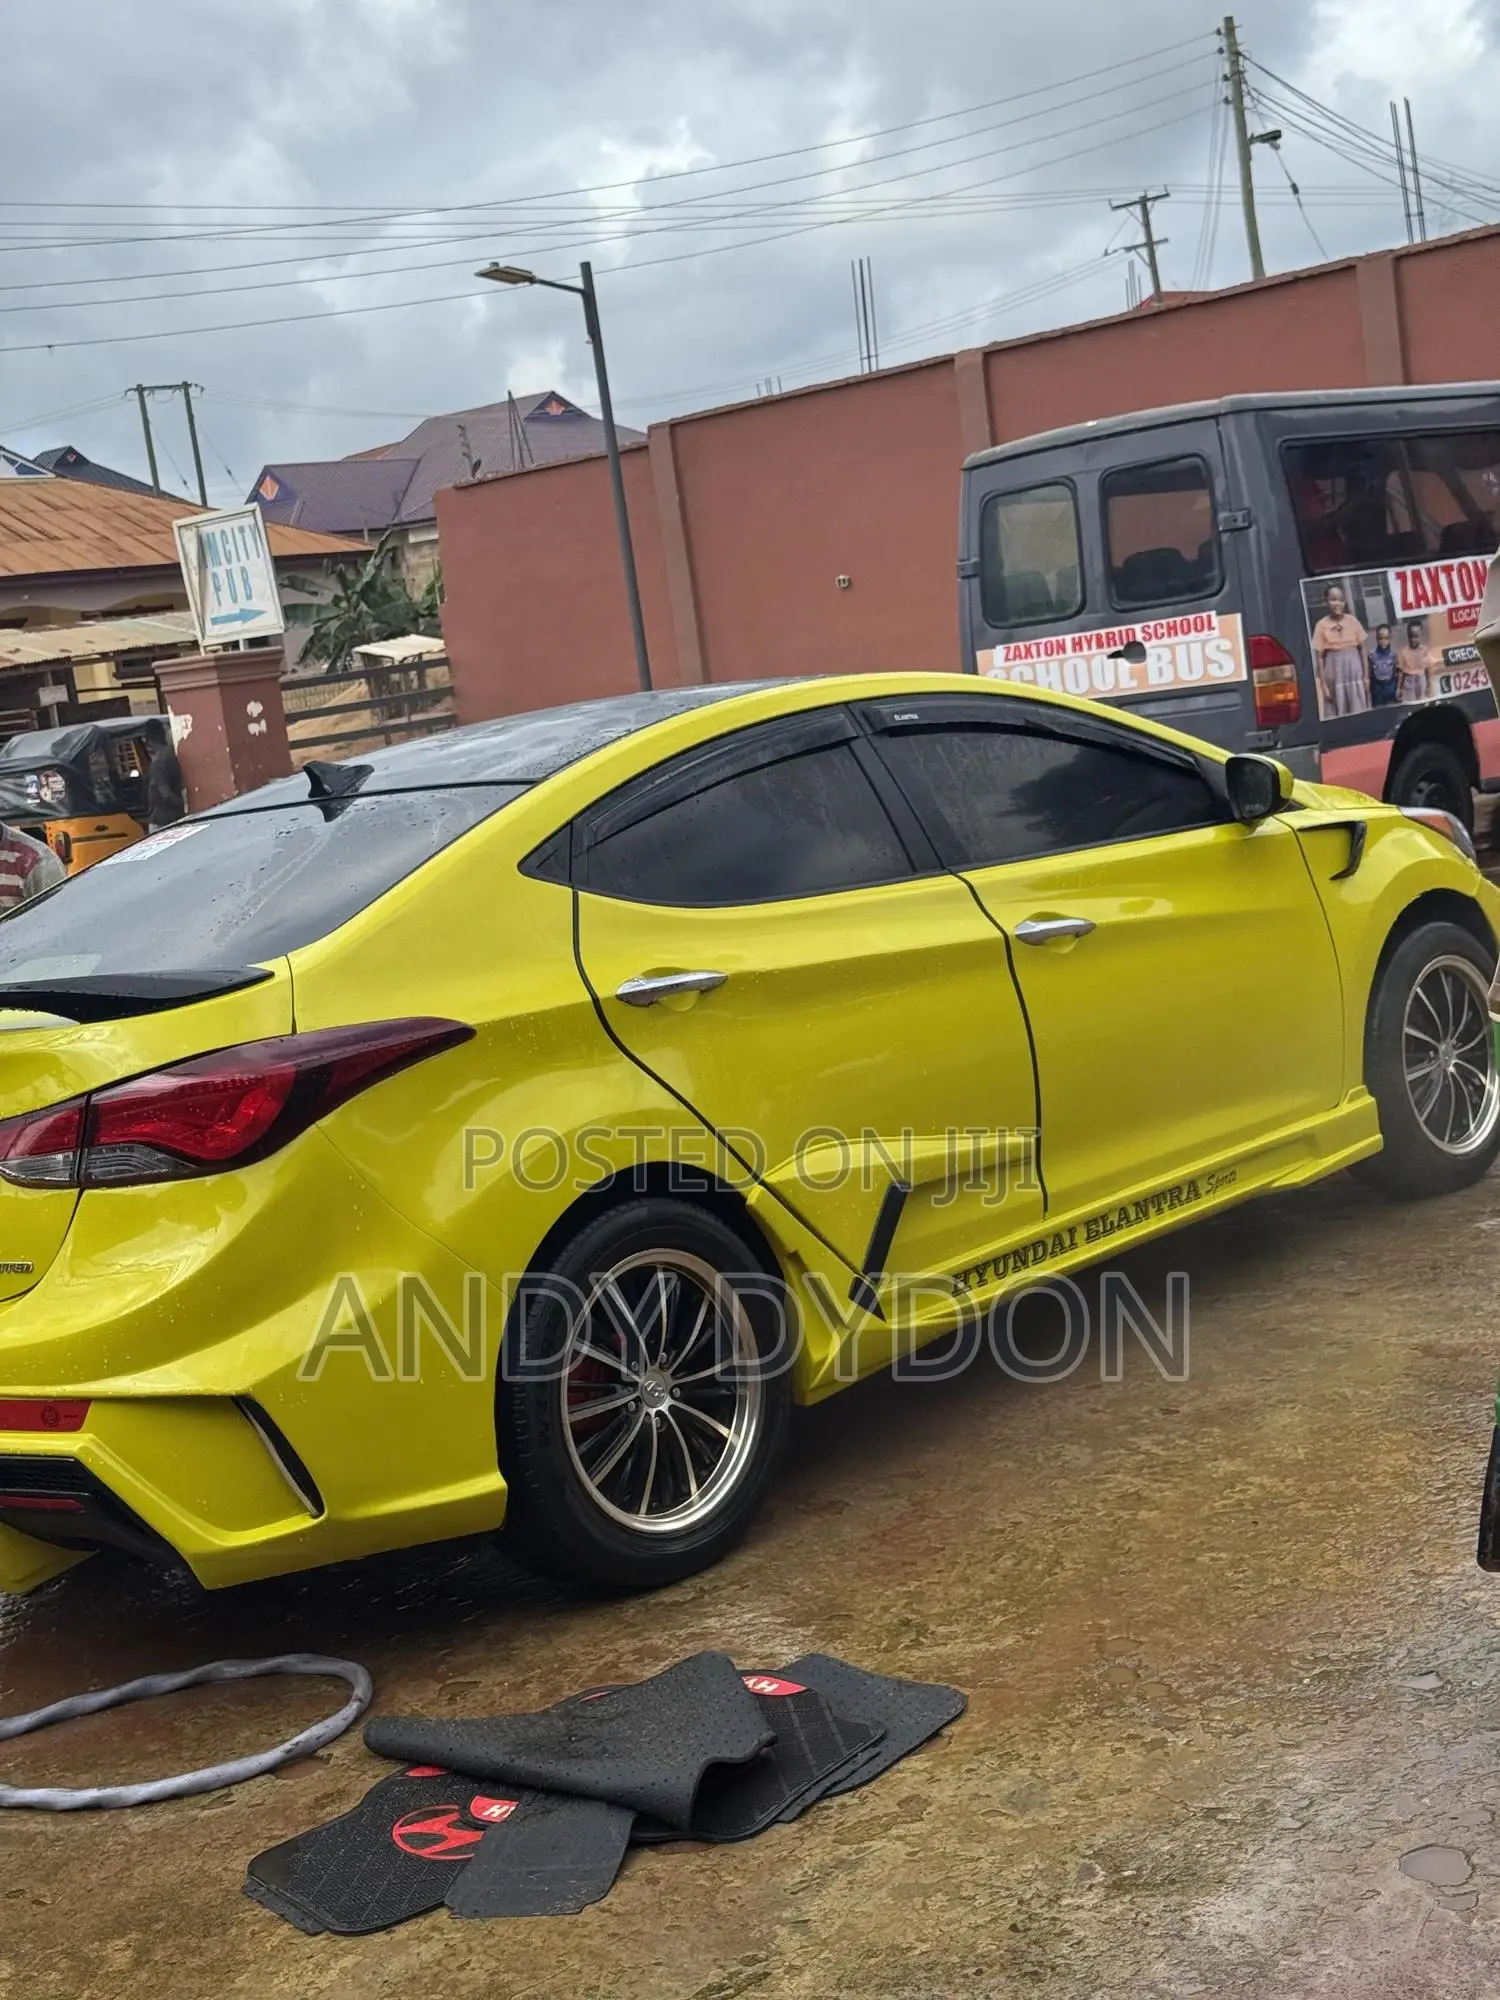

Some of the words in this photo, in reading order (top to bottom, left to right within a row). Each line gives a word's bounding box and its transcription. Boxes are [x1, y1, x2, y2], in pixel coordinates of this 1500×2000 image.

[212, 566, 253, 606] PUB
[1395, 559, 1488, 611] ZAXTON
[1003, 638, 1067, 662] ZAXTON
[1070, 627, 1136, 653] HYBRID
[1141, 614, 1216, 642] SCHOOL
[1146, 639, 1235, 685] BUS
[952, 1227, 1079, 1297] HYUNDAI
[1084, 1180, 1202, 1245] ELANTRA
